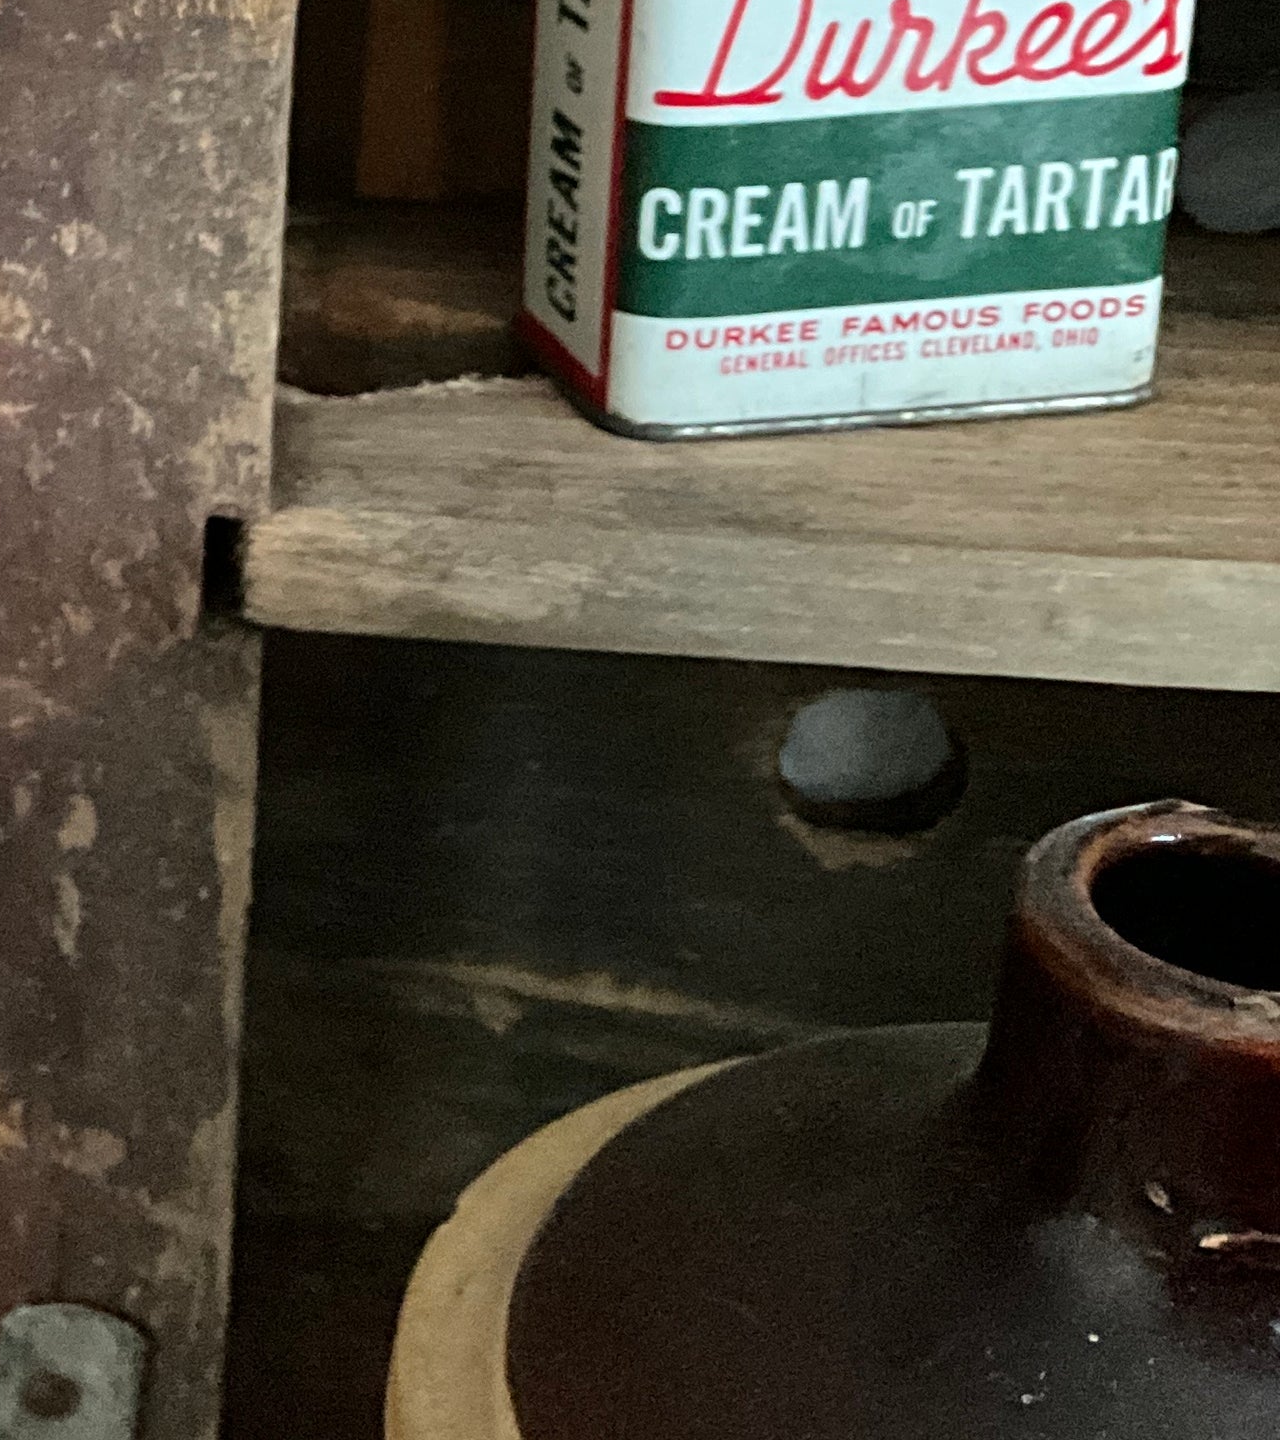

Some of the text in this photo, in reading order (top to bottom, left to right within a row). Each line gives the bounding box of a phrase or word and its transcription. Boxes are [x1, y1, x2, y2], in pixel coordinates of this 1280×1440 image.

[546, 108, 585, 323] CREAM
[640, 147, 1179, 261] CREAM OF TARTAR
[666, 294, 1147, 352] DURKEE FAMOUS FOODS
[719, 349, 809, 376] GENERAL
[823, 341, 906, 364] OFFICES
[1051, 328, 1099, 349] OHIO
